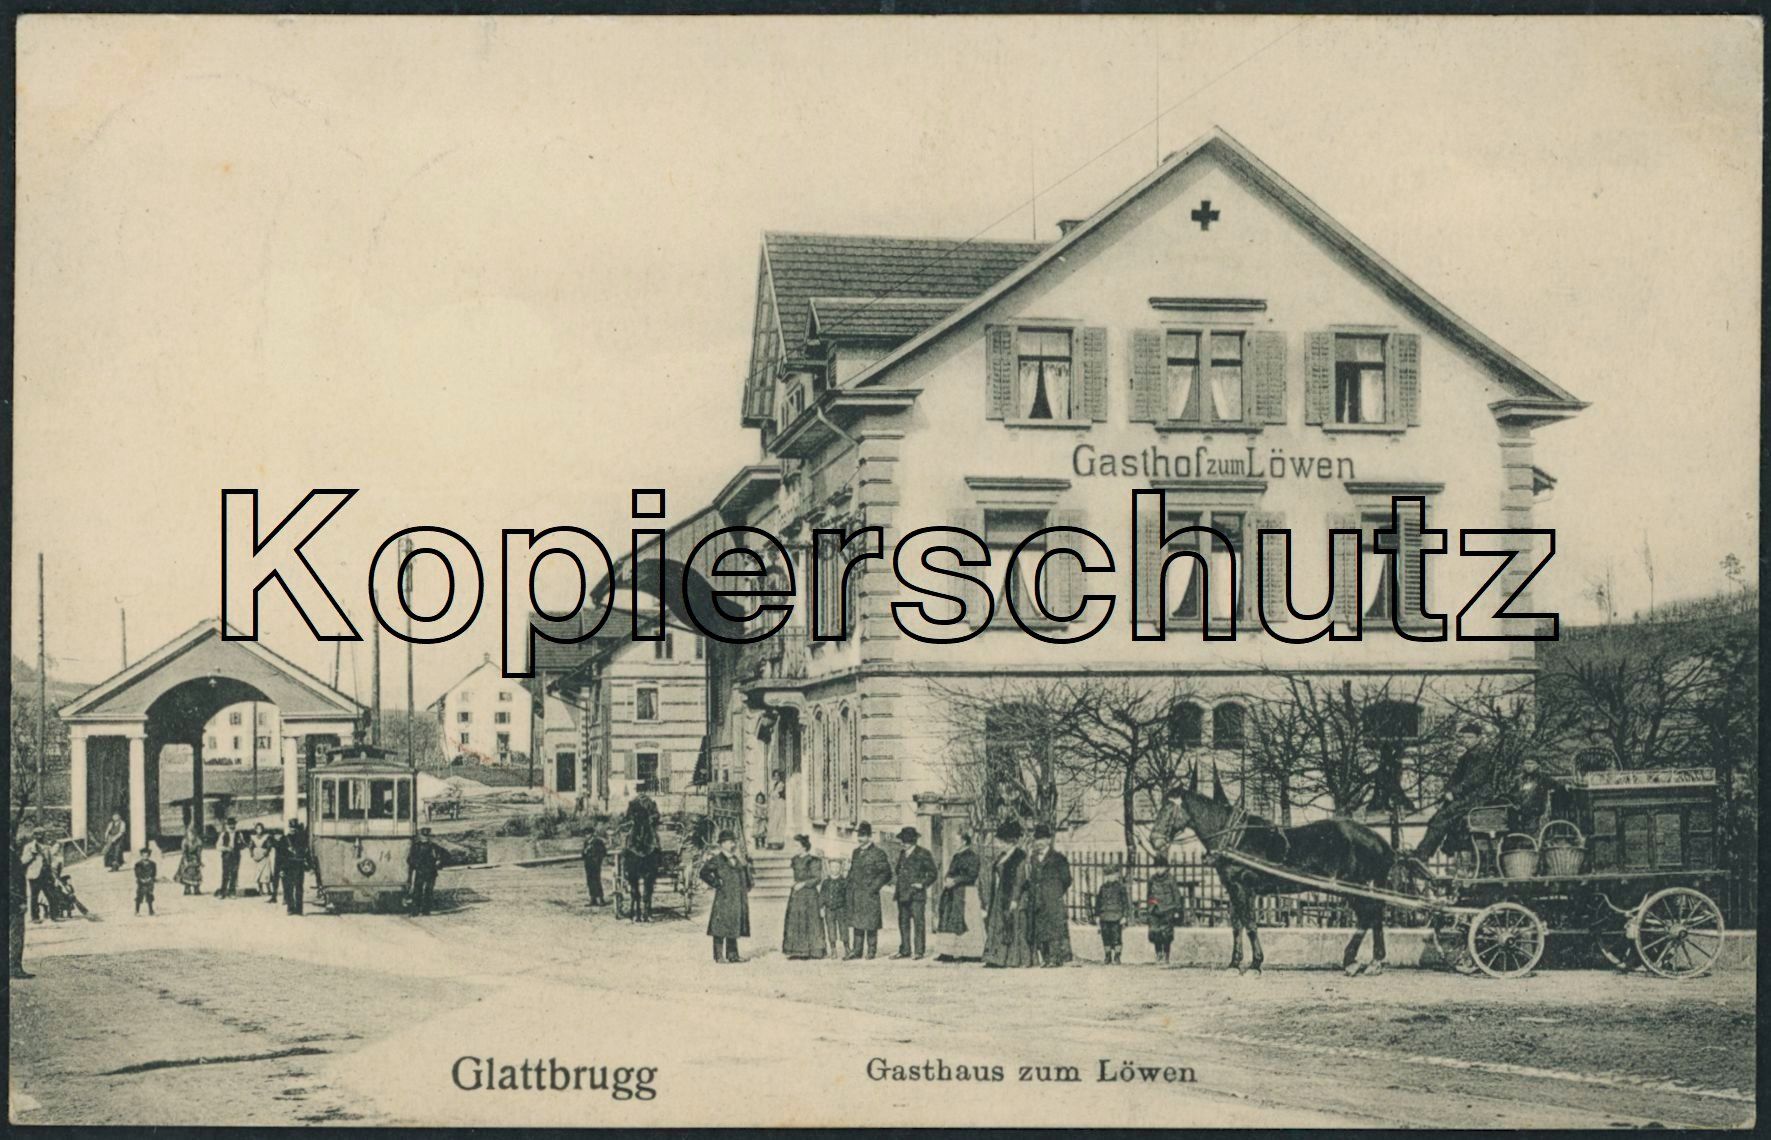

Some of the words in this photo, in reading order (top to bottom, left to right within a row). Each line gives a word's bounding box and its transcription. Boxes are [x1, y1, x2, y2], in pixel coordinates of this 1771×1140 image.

[1072, 444, 1207, 477] Gasthof
[1206, 458, 1244, 475] zum
[1246, 446, 1356, 479] Löwen
